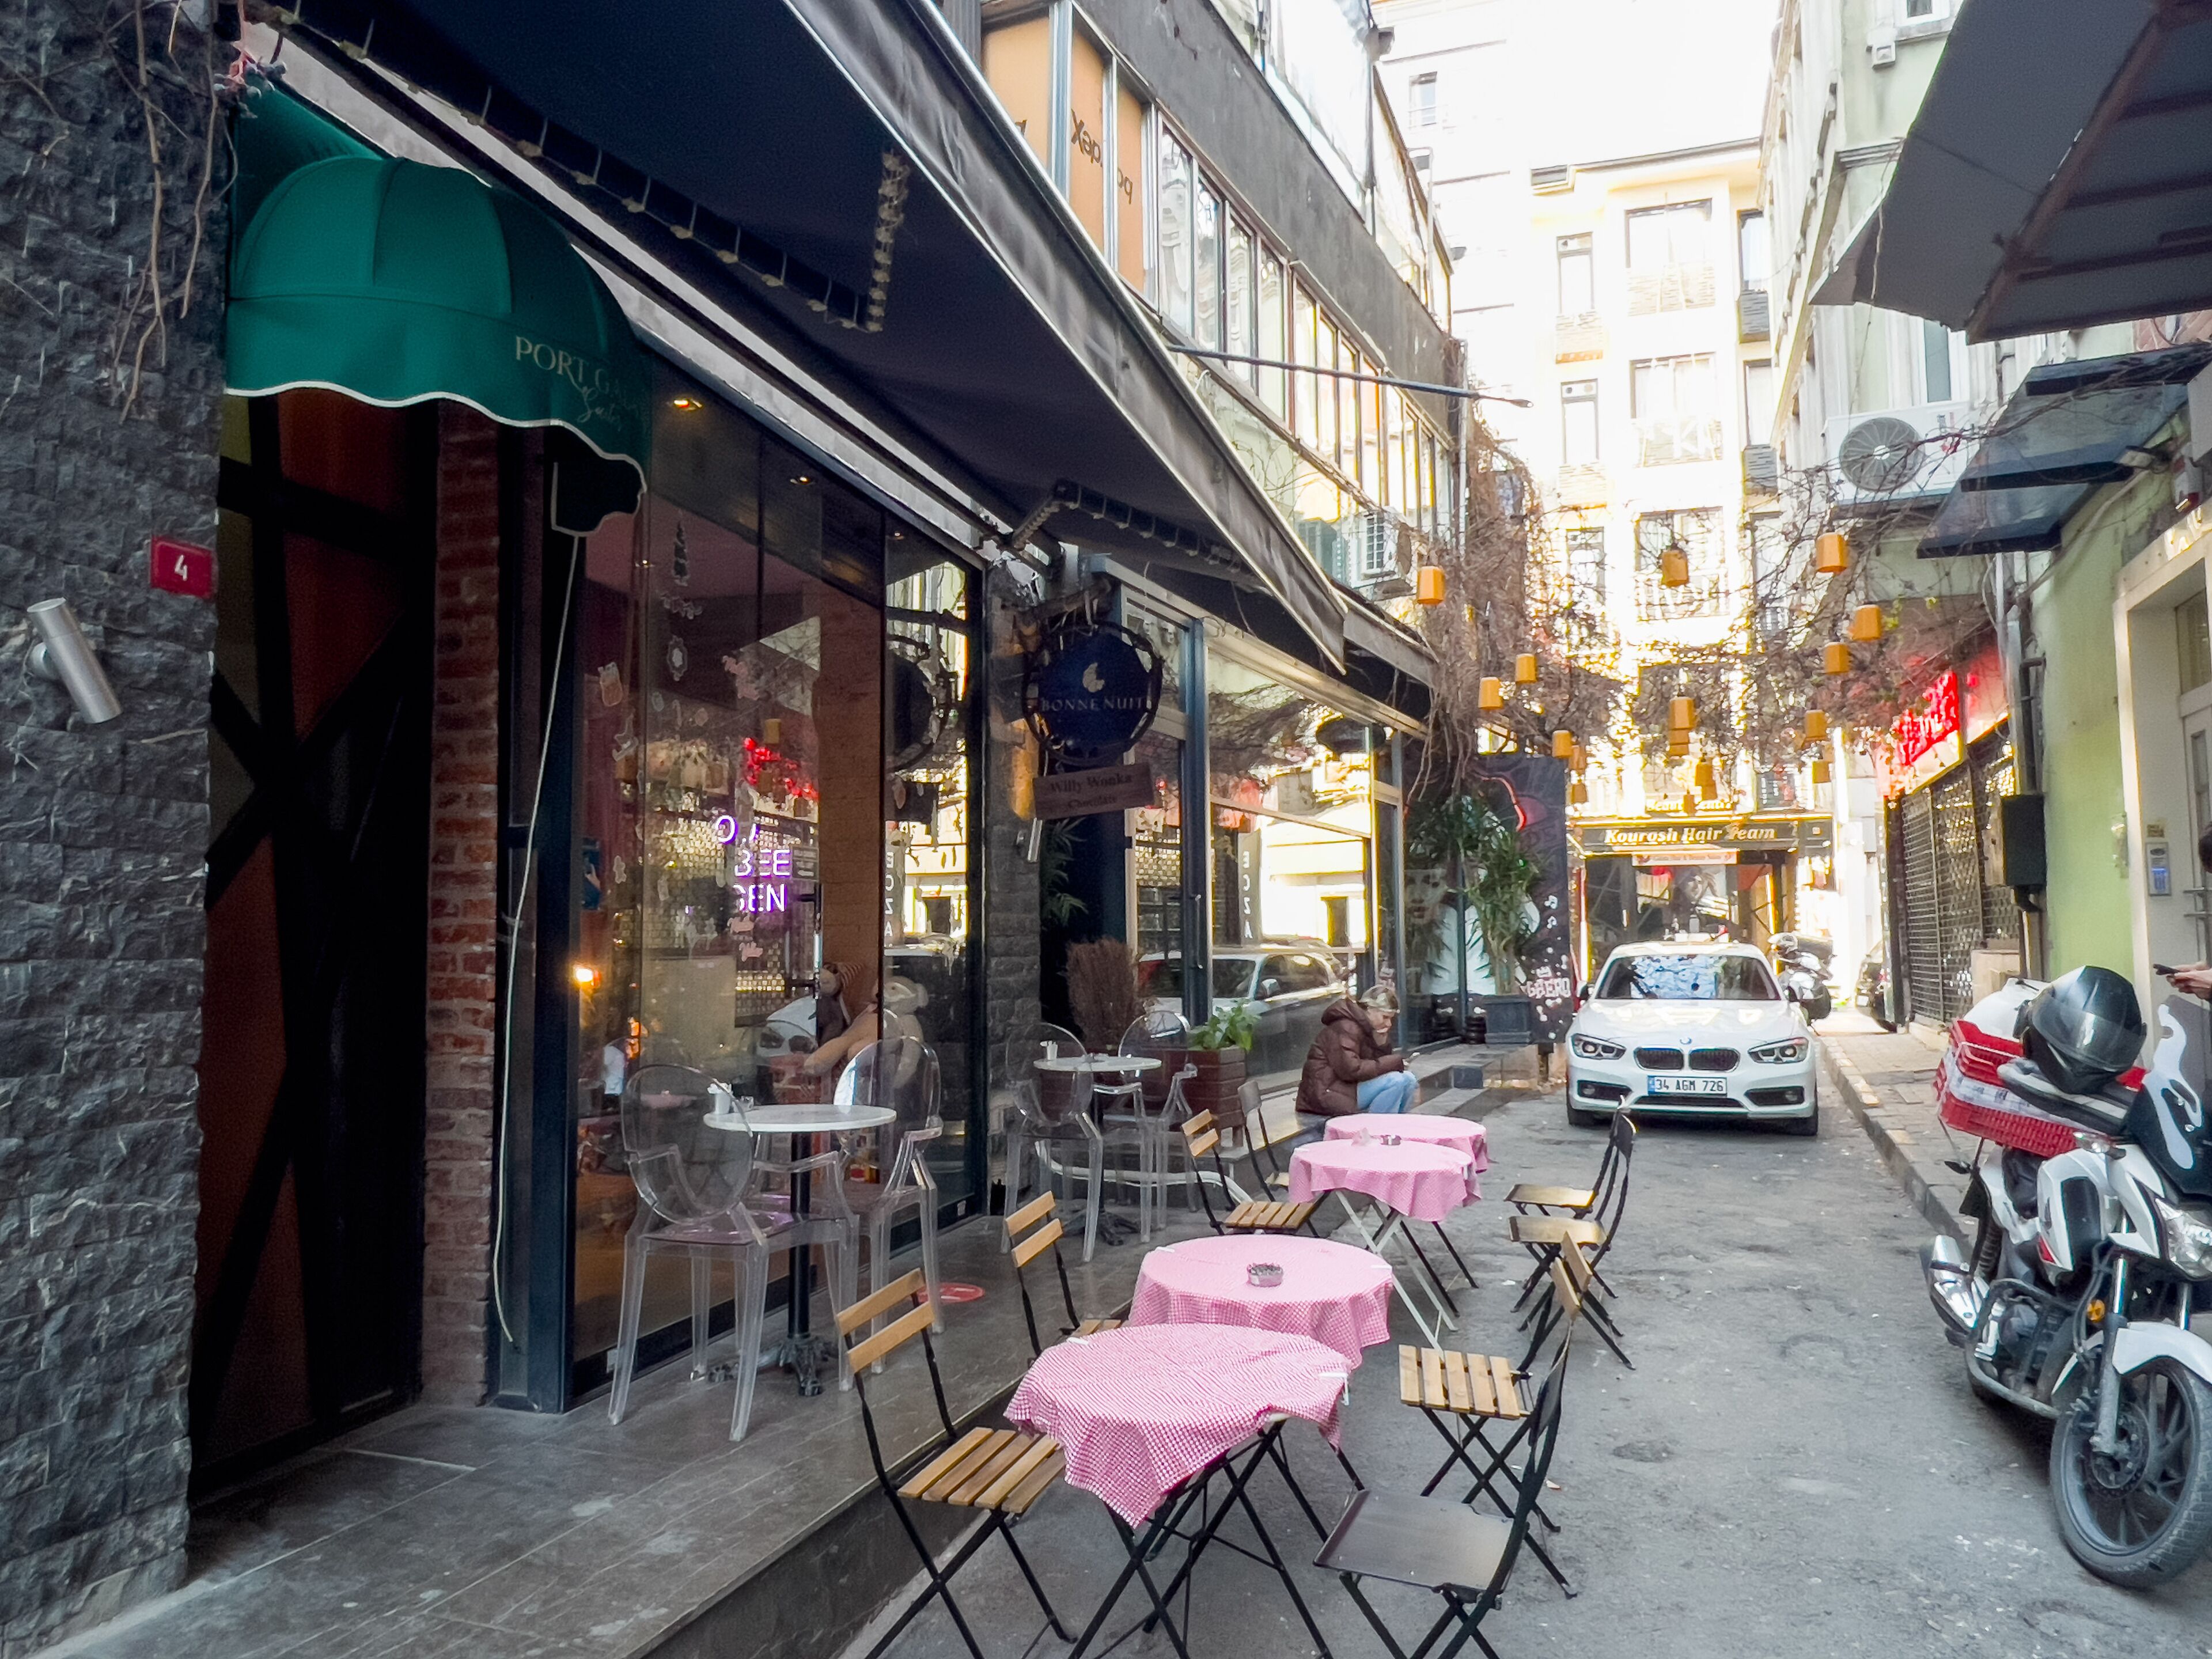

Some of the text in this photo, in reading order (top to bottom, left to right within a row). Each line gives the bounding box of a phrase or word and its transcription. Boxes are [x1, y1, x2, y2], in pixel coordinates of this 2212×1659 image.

[516, 335, 588, 386] PORT
[175, 555, 188, 581] 4
[1041, 695, 1145, 712] BONNE NUIT
[1050, 772, 1133, 794] Willy Wonka
[1681, 827, 1722, 842] Hair
[1727, 826, 1775, 840] Team
[1655, 1079, 1724, 1092] 34 AGM 726
